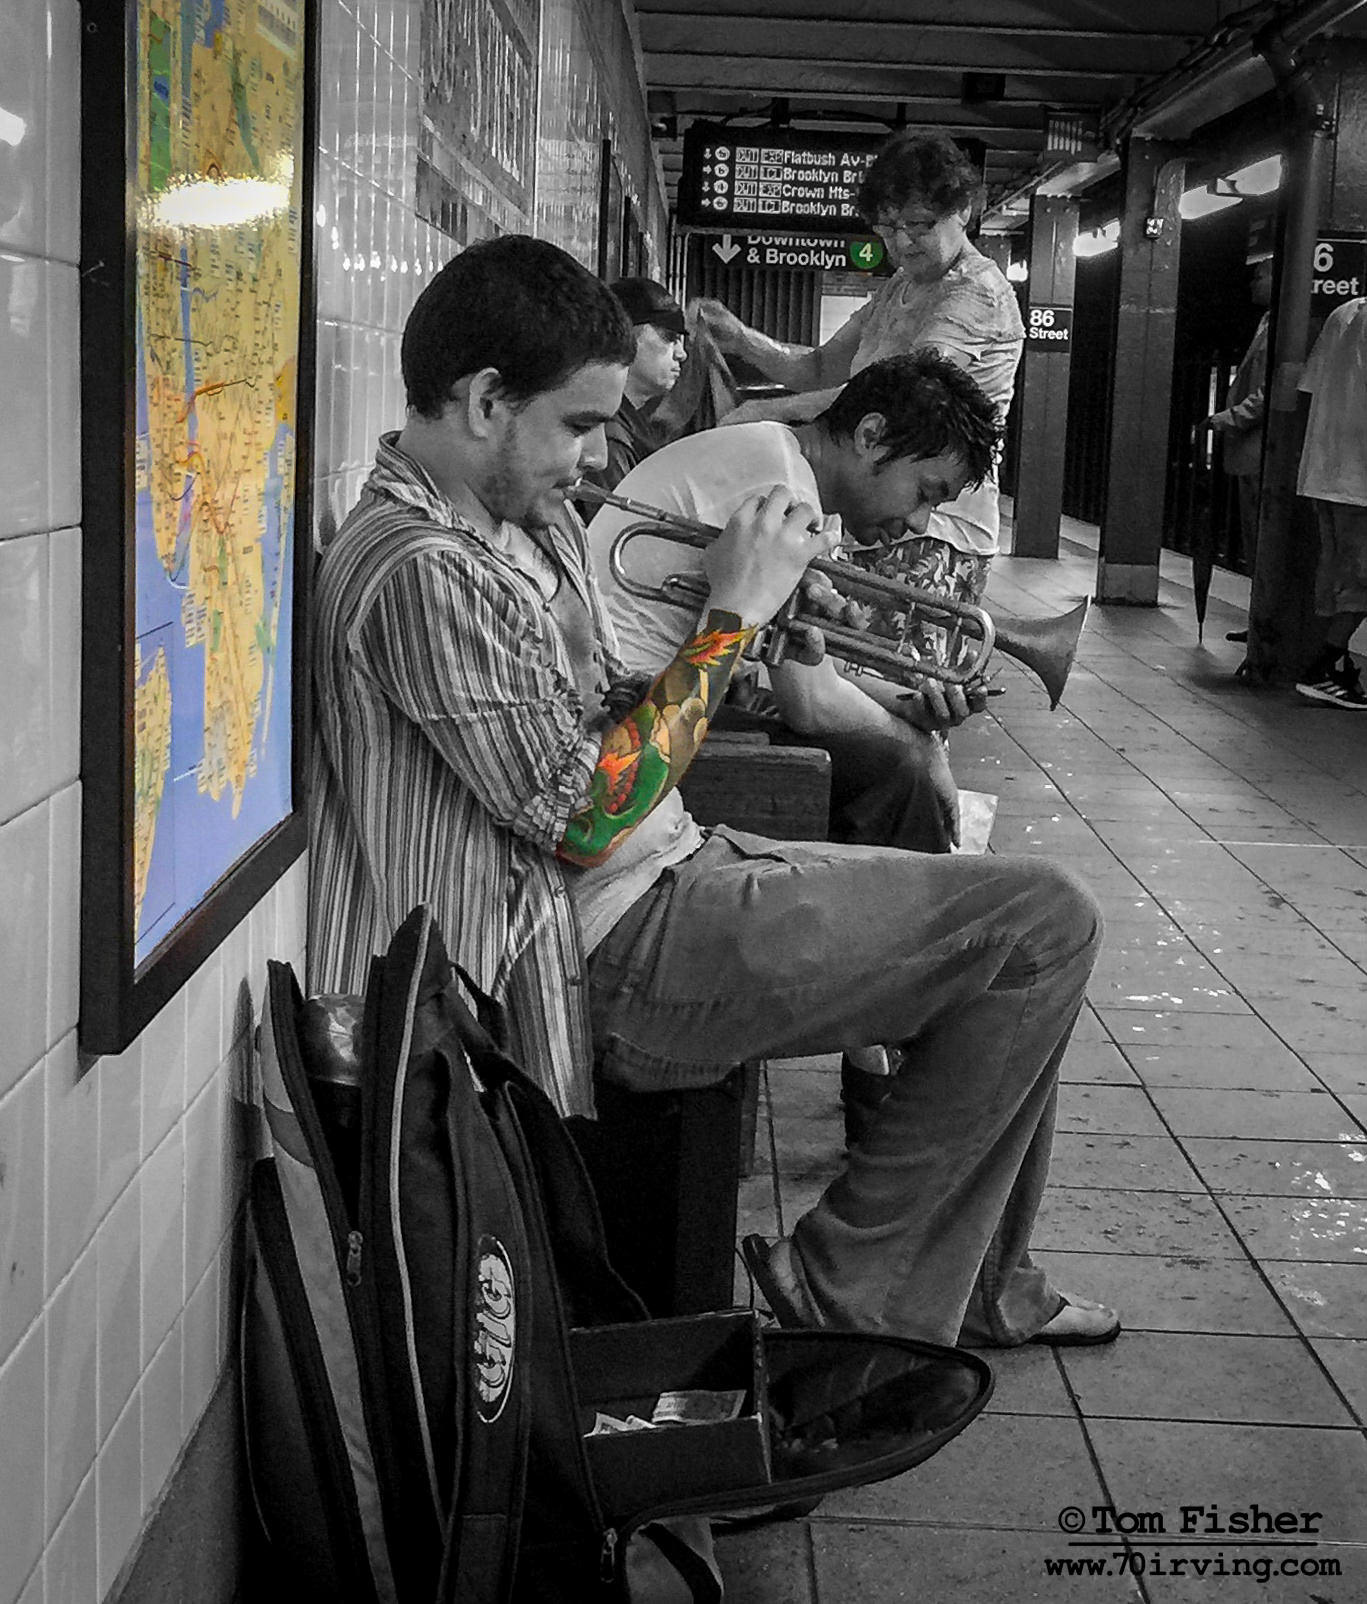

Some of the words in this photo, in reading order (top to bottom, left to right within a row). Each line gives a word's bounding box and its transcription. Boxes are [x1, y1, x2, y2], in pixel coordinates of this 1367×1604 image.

[784, 150, 835, 166] Flatbush
[840, 152, 878, 167] Av-B
[784, 168, 838, 183] Brooklyn
[783, 184, 824, 198] Crown
[828, 186, 860, 199] Hts-
[782, 200, 836, 216] Brooklyn
[747, 248, 760, 263] &
[766, 248, 846, 269] Brooklyn
[859, 242, 873, 261] 4
[1313, 242, 1334, 272] 6
[1310, 277, 1360, 296] reet
[1030, 309, 1054, 327] 86
[1029, 327, 1068, 340] Street
